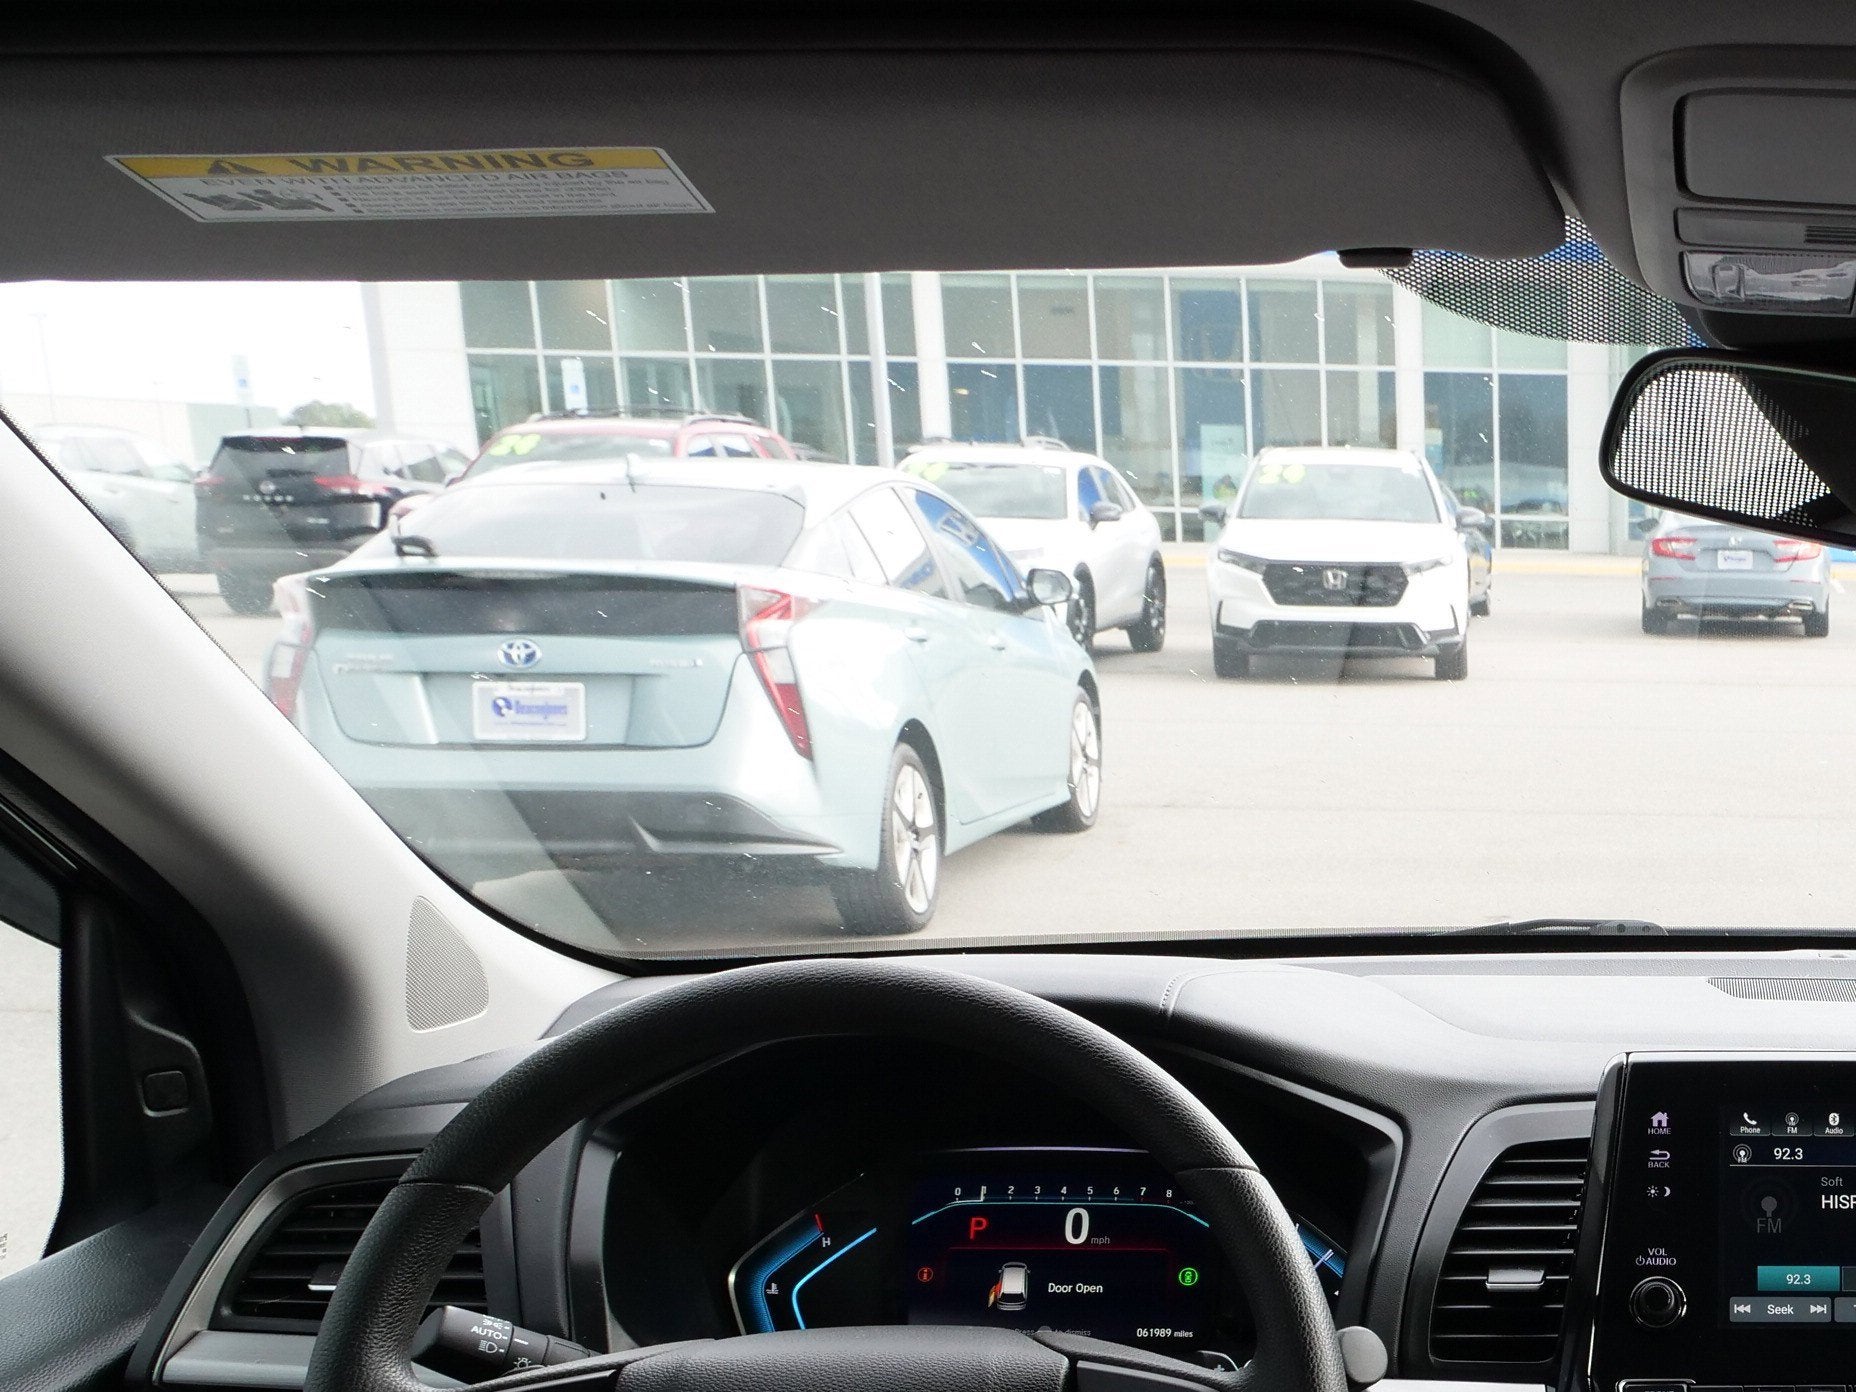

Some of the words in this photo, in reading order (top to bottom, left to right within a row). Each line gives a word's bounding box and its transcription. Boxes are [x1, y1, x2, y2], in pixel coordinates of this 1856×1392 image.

[288, 152, 594, 173] WARNING
[1647, 1127, 1672, 1135] HOME
[1740, 1126, 1761, 1135] Phone
[1786, 1126, 1797, 1134] FM
[1824, 1126, 1844, 1135] Audio
[1773, 1147, 1804, 1160] 92.3
[1647, 1161, 1671, 1169] BACK
[1820, 1176, 1844, 1187] Soft
[954, 1187, 961, 1197] 0
[1008, 1185, 1015, 1195] 2
[1034, 1185, 1041, 1195] 3
[1060, 1186, 1067, 1195] 4
[1087, 1186, 1094, 1195] 5
[1113, 1186, 1120, 1195] 6
[1140, 1187, 1147, 1196] 7
[1165, 1189, 1173, 1199] 8
[969, 1216, 989, 1240] P
[1064, 1207, 1090, 1244] 0
[1090, 1235, 1111, 1246] mph
[1756, 1217, 1782, 1234] FM
[1647, 1247, 1668, 1256] VOL
[1645, 1256, 1677, 1266] AUDIO
[1786, 1273, 1812, 1285] 92.3
[1047, 1282, 1073, 1293] Door
[1075, 1282, 1104, 1295] Open
[1766, 1304, 1794, 1315] Seek
[470, 1325, 503, 1340] AUTO
[1136, 1327, 1172, 1338] 061989
[1173, 1329, 1194, 1338] miles
